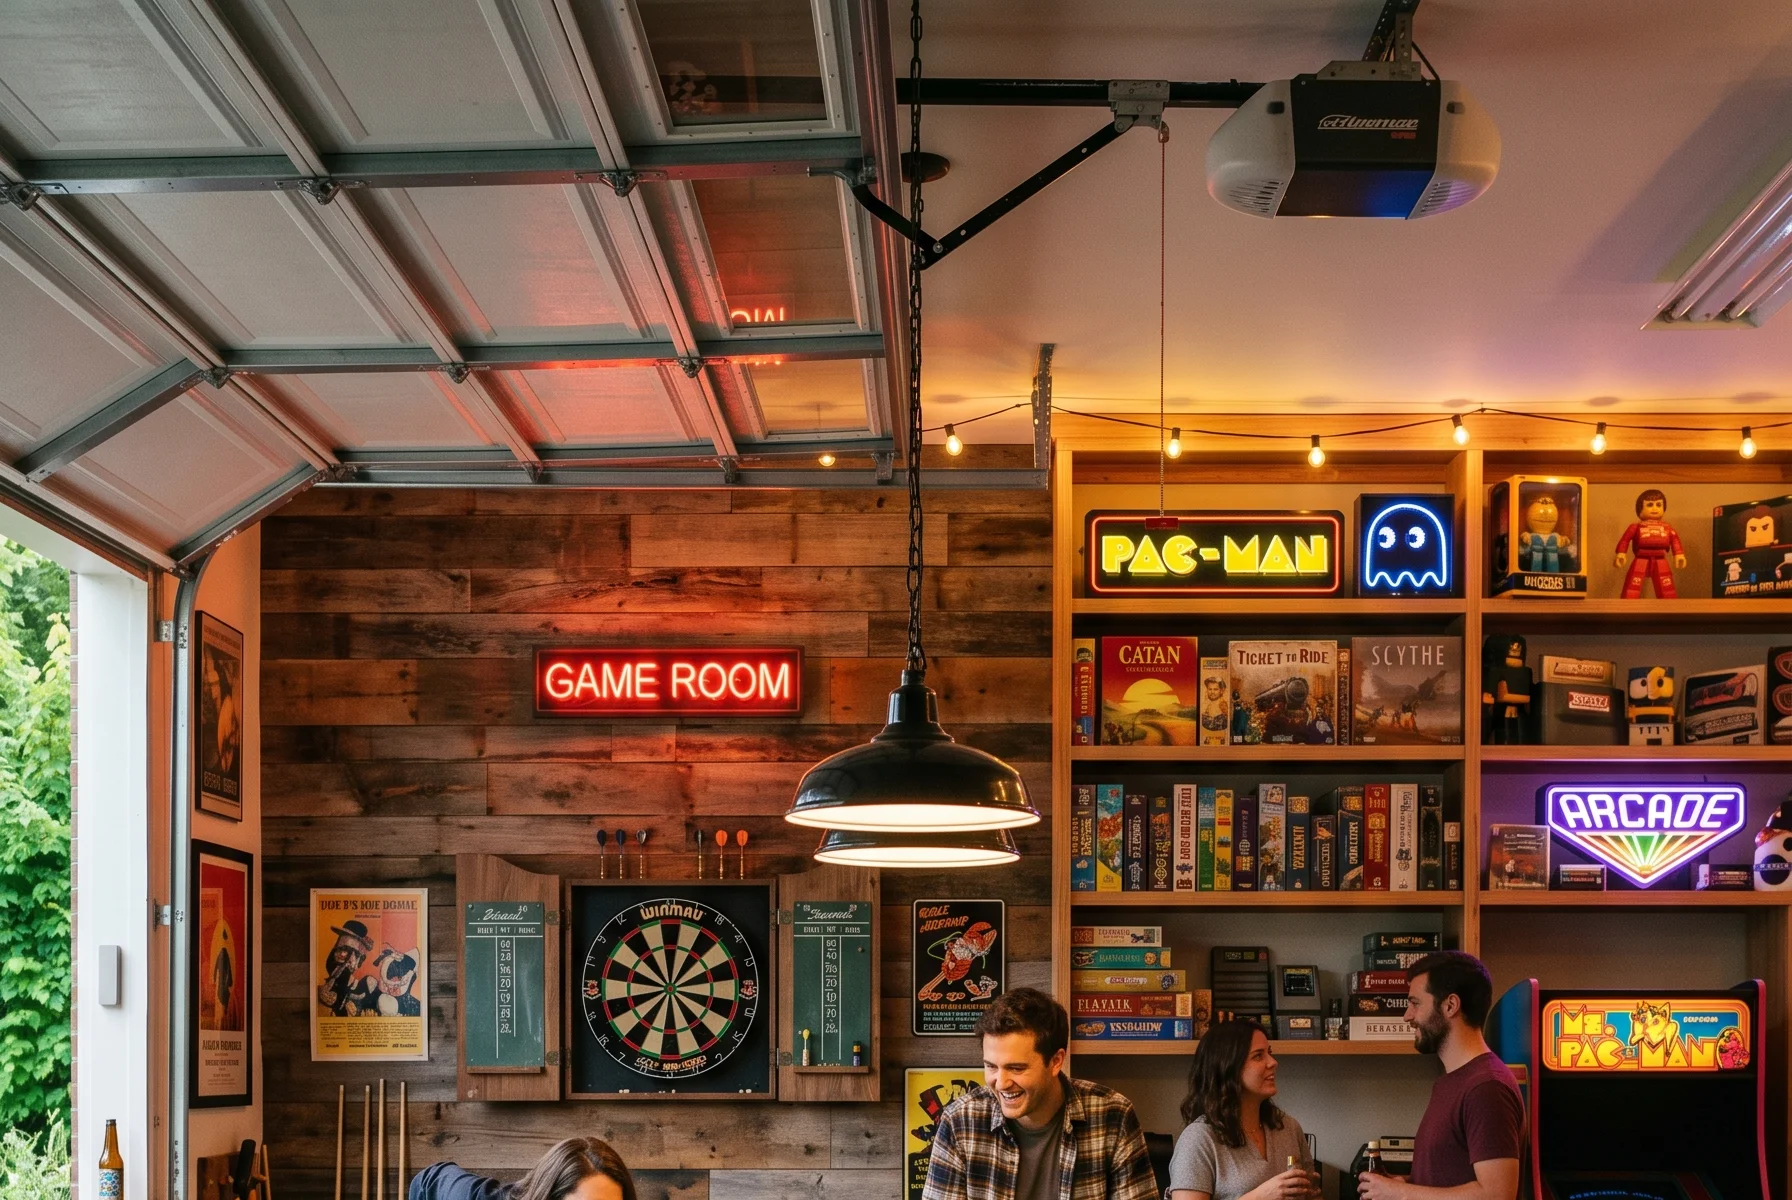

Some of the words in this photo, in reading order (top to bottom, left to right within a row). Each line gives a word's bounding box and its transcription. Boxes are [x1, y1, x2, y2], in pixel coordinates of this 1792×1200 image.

[1101, 535, 1329, 575] PAC-MAN
[1119, 645, 1181, 664] CATAN
[1237, 650, 1283, 665] TICKET
[1299, 648, 1330, 664] RIDE
[1372, 645, 1444, 666] SCYTHE
[545, 662, 659, 699] GAME
[671, 662, 790, 699] ROOM
[1559, 793, 1735, 829] ARCADE
